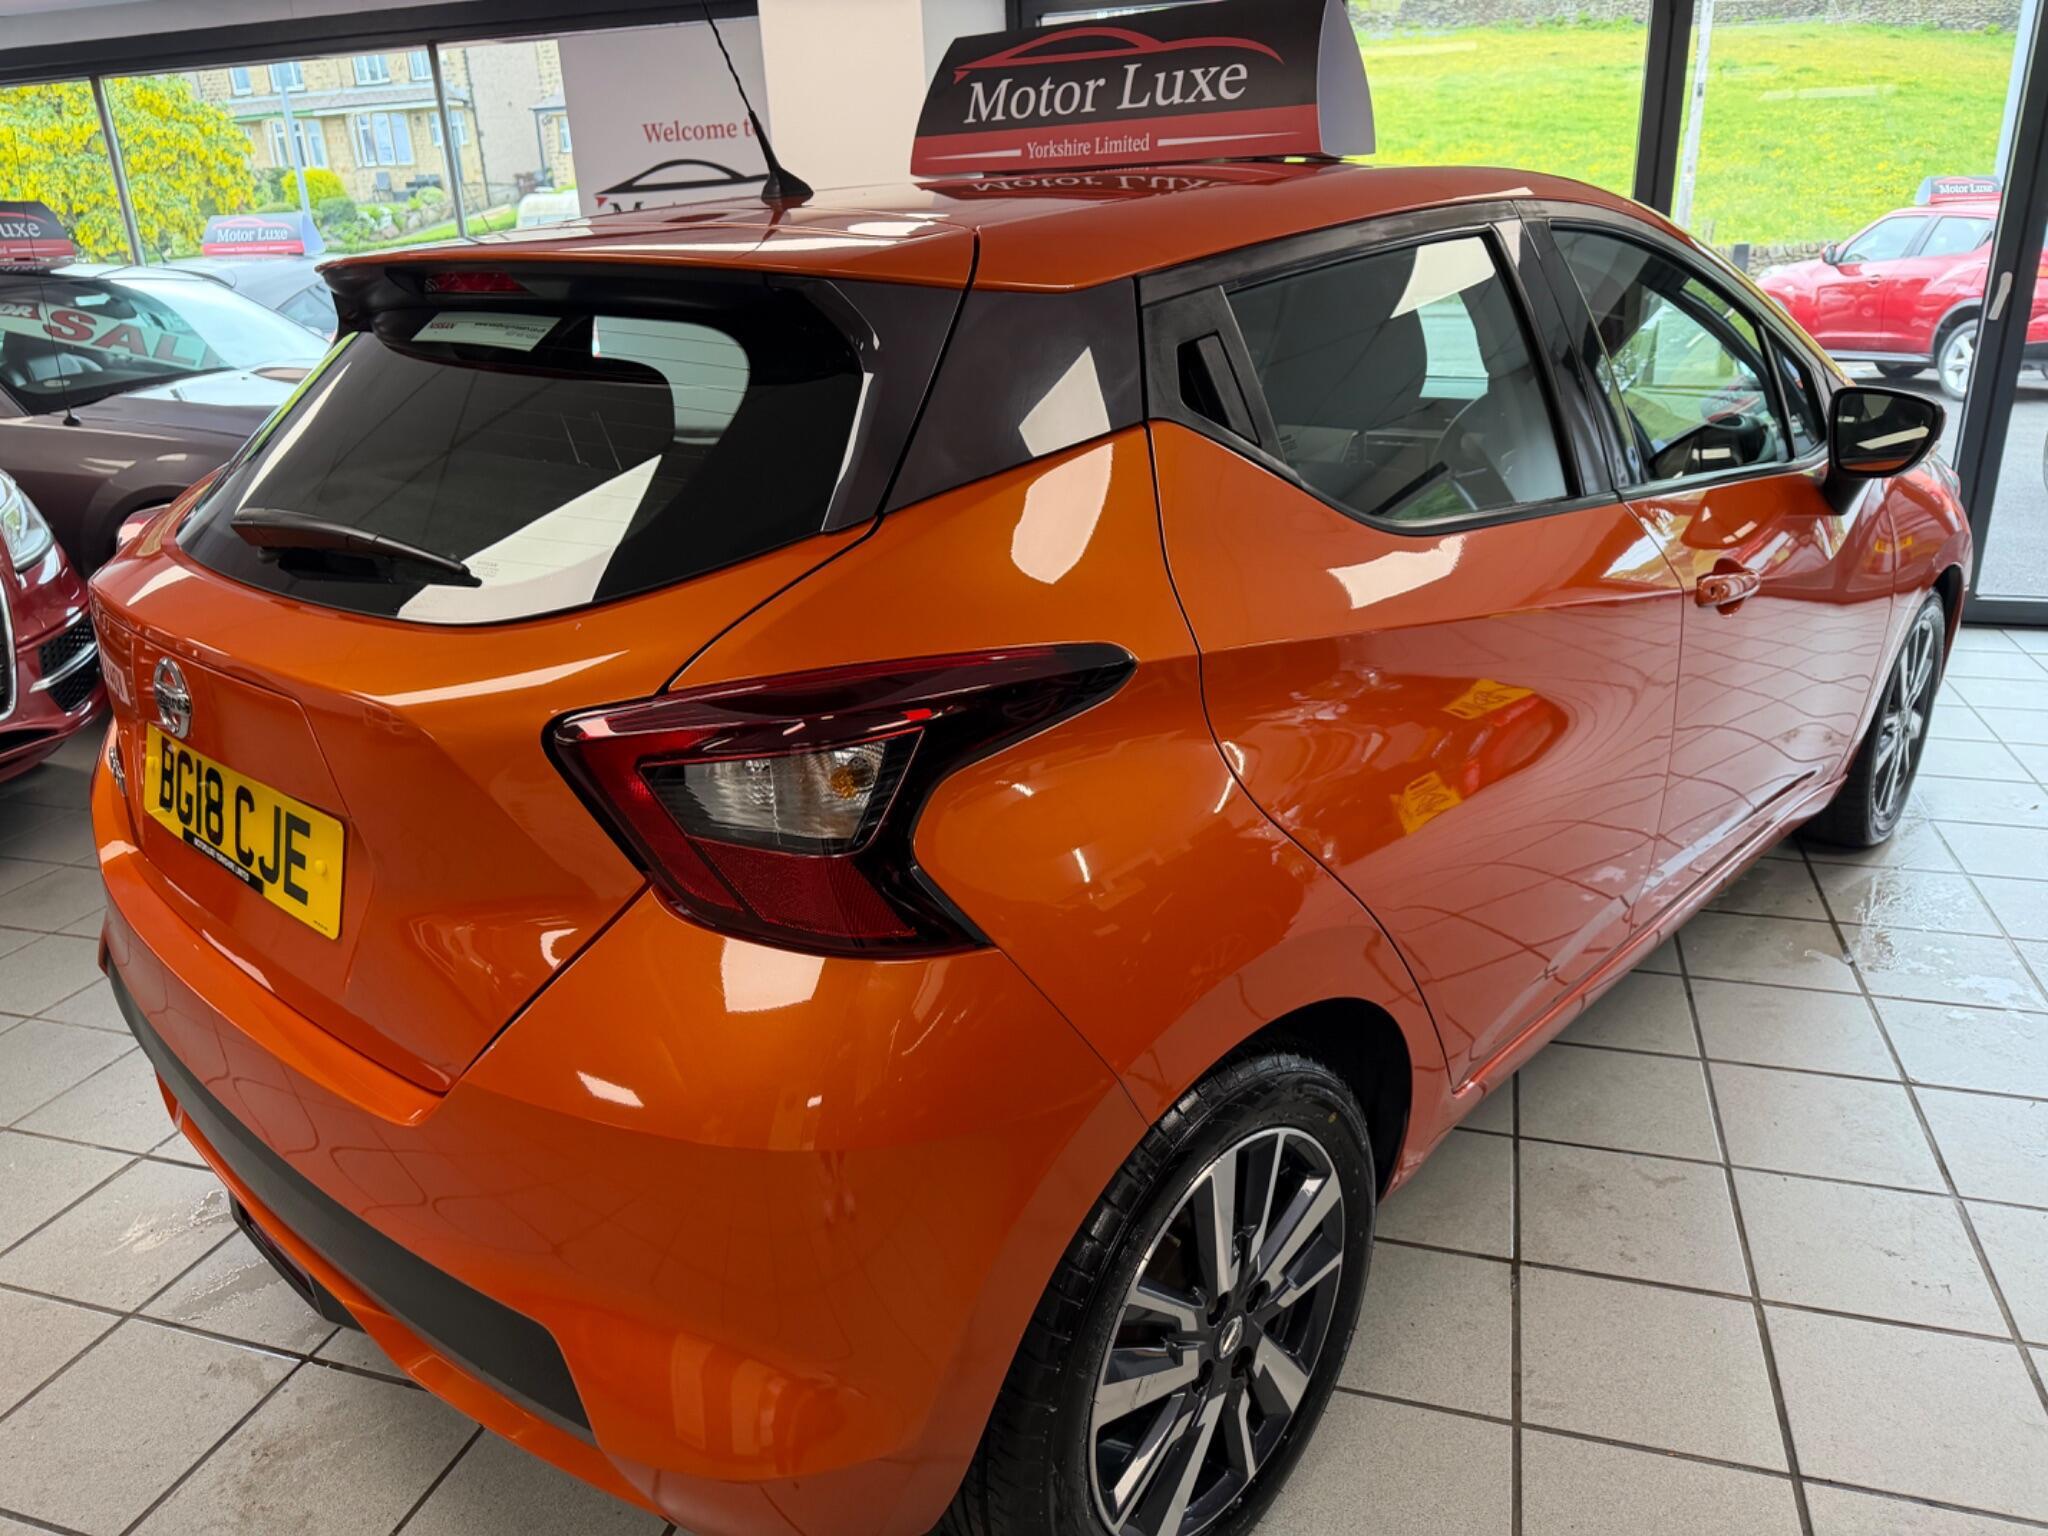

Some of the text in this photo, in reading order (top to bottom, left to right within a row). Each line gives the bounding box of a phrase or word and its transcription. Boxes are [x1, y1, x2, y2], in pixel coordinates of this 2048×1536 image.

[963, 61, 1248, 124] Motor Luxe
[642, 120, 738, 144] Welcome
[1027, 133, 1150, 159] Yorkshire Limited
[217, 227, 288, 243] Motor Luxe
[159, 736, 224, 846] BG18
[235, 785, 311, 906] CJE
